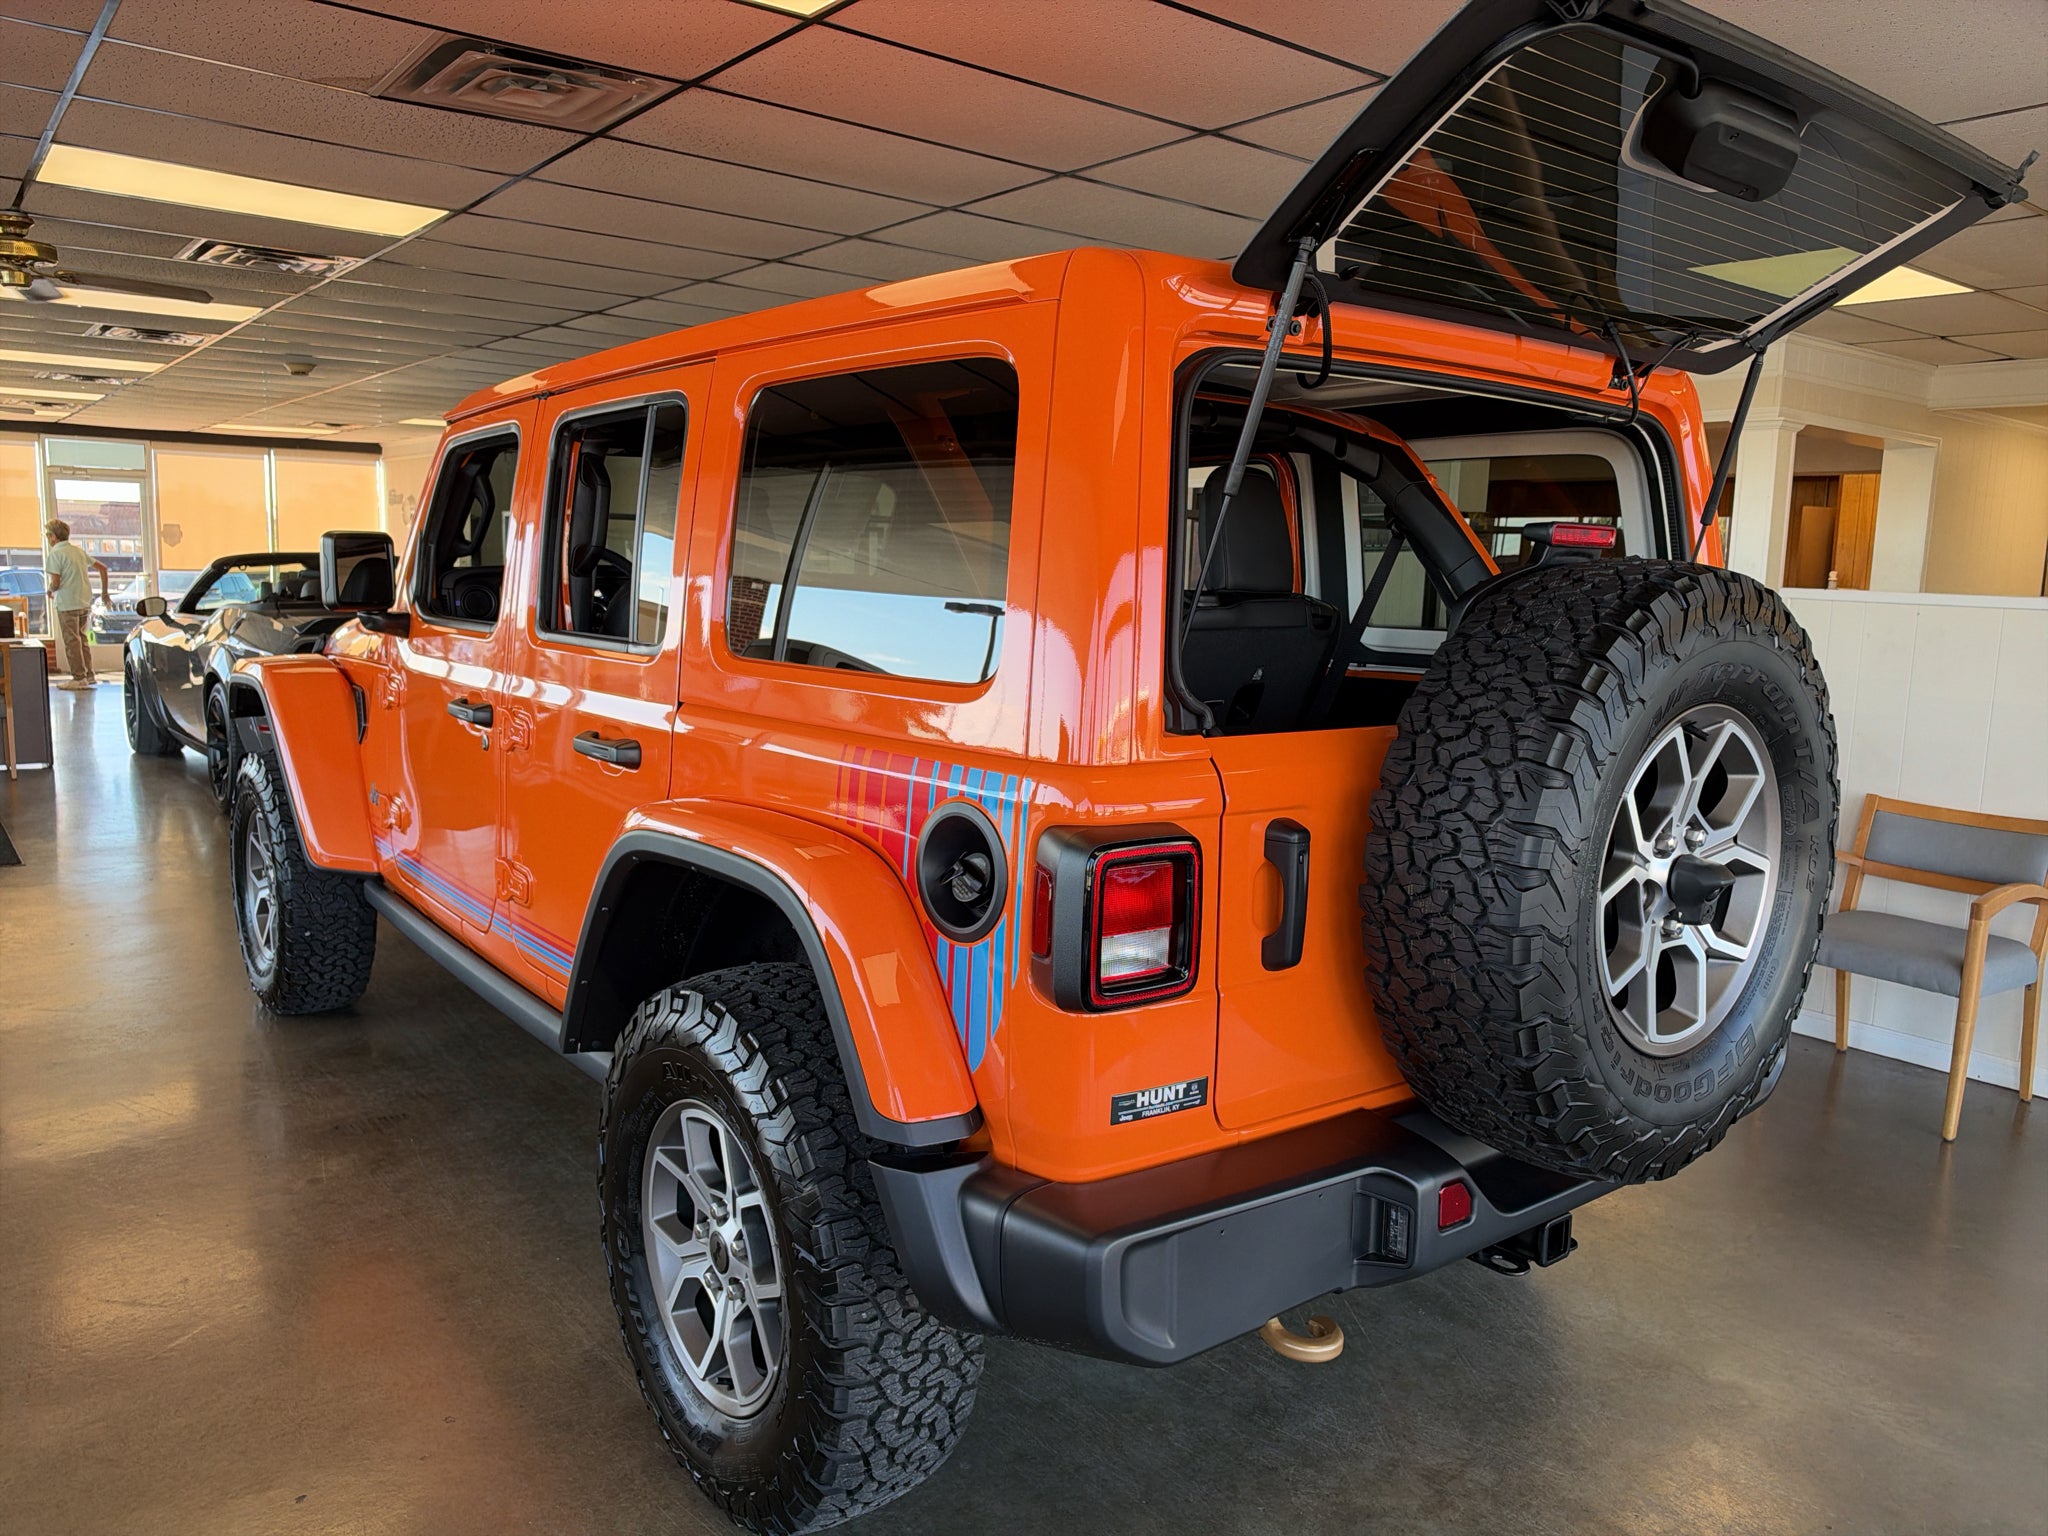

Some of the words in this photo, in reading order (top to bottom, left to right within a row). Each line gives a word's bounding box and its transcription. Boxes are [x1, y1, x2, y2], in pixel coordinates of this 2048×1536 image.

[1136, 1083, 1188, 1108] HUNT
[1119, 1113, 1133, 1122] Jeep
[1141, 1106, 1171, 1118] FRANKLIN,
